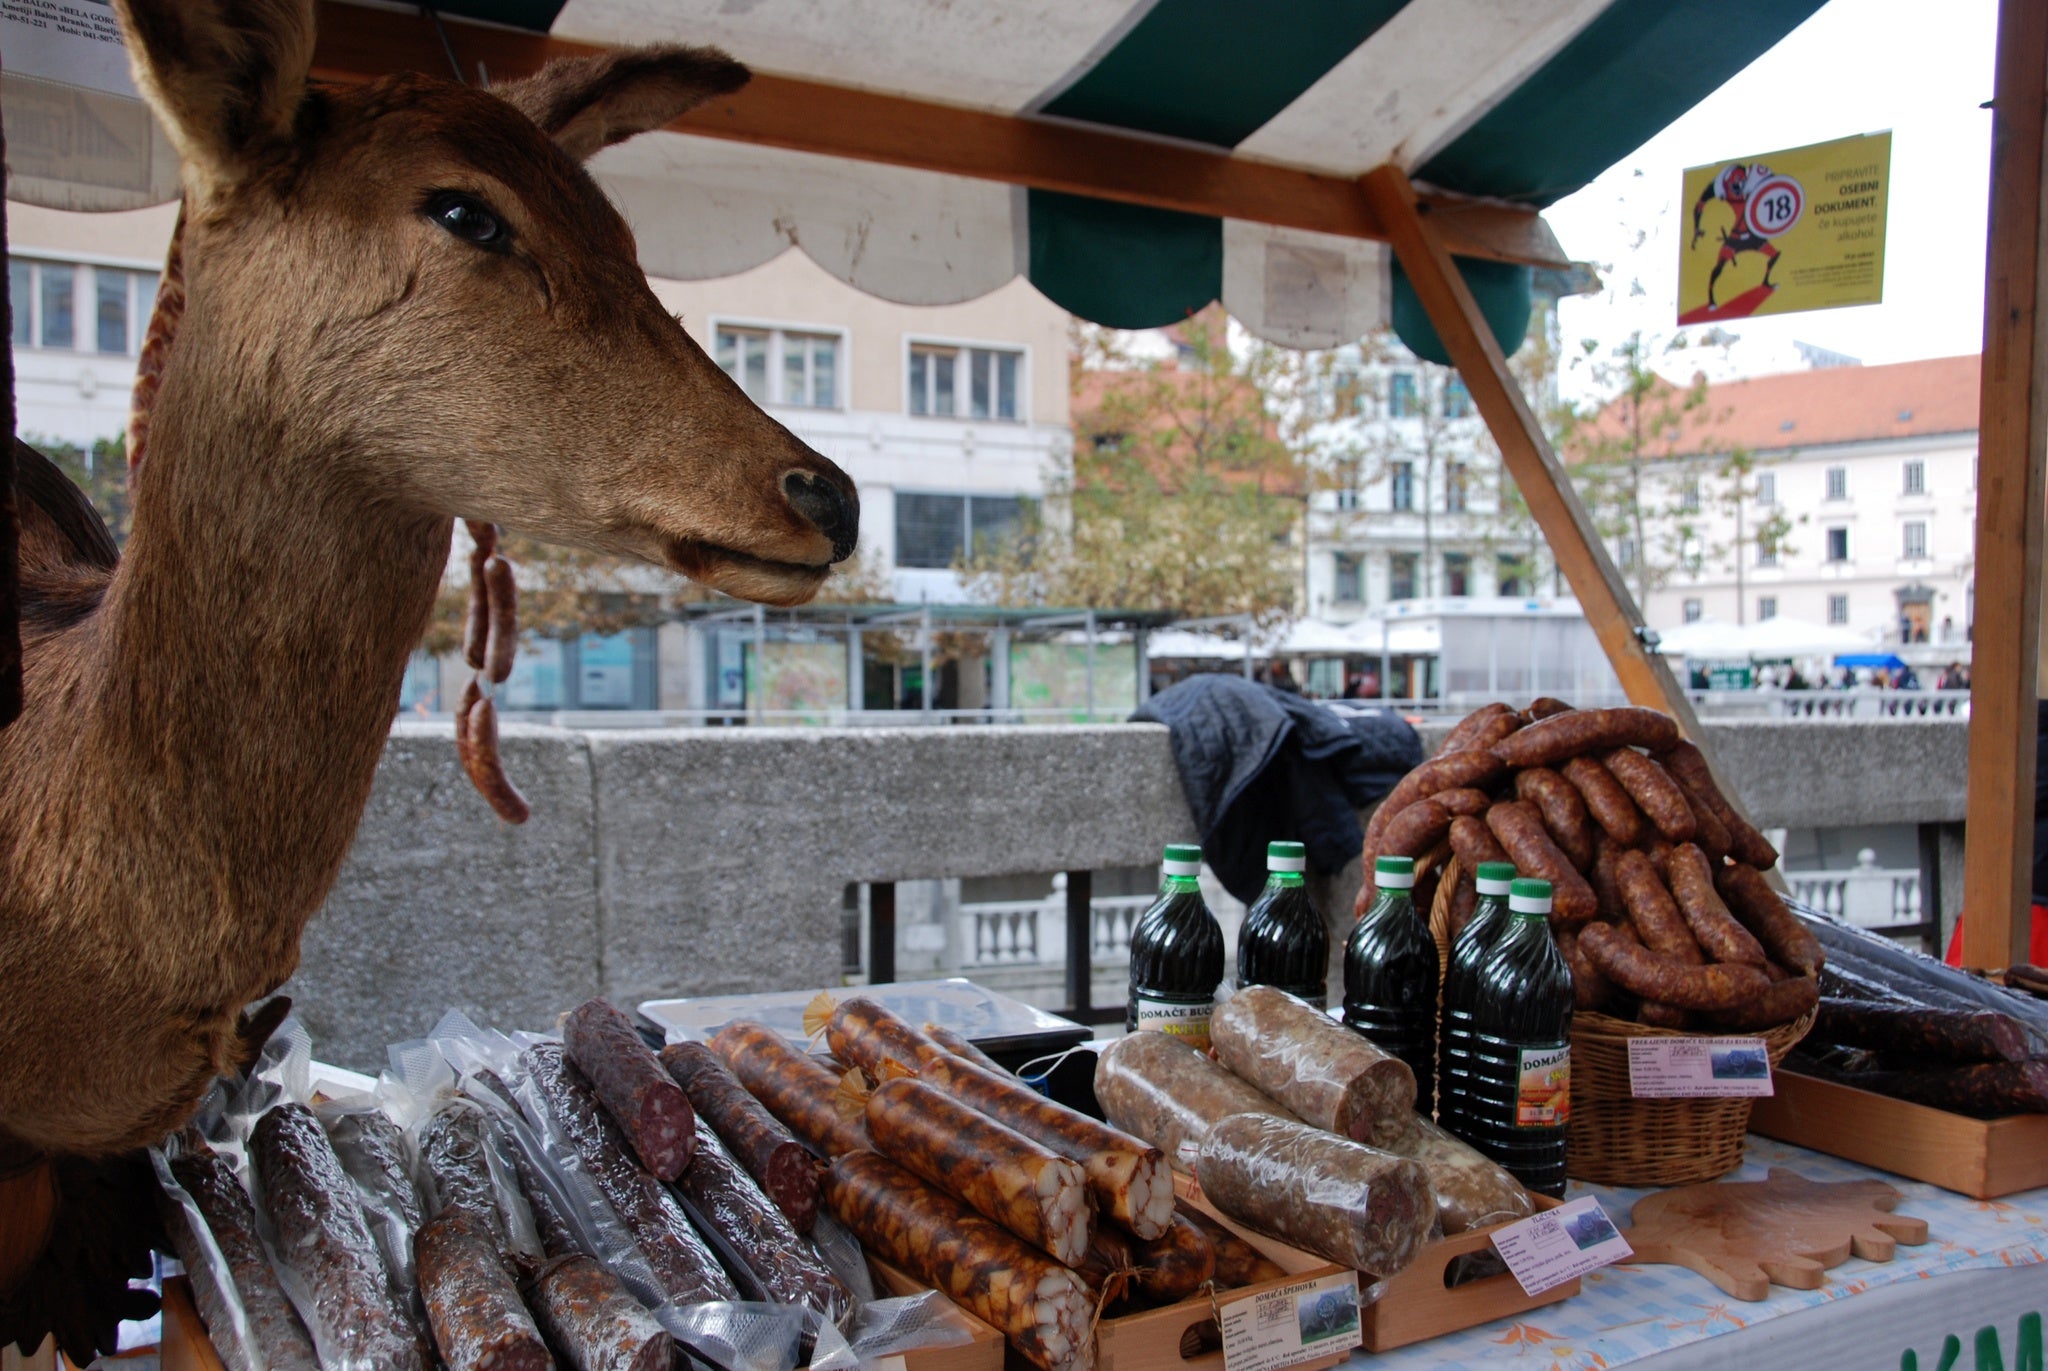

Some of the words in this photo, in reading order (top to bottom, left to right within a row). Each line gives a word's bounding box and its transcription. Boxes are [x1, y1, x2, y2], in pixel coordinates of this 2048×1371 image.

[34, 9, 58, 21] Balon
[90, 13, 118, 26] GORC
[57, 24, 81, 37] Mobi:
[1825, 164, 1880, 182] PRIPRAVITE
[1839, 181, 1879, 196] OSEBNI
[1764, 194, 1791, 223] 18
[1832, 213, 1877, 230] kupujete
[1140, 1007, 1187, 1020] DOMAČE
[1255, 1289, 1283, 1303] DOMAČA
